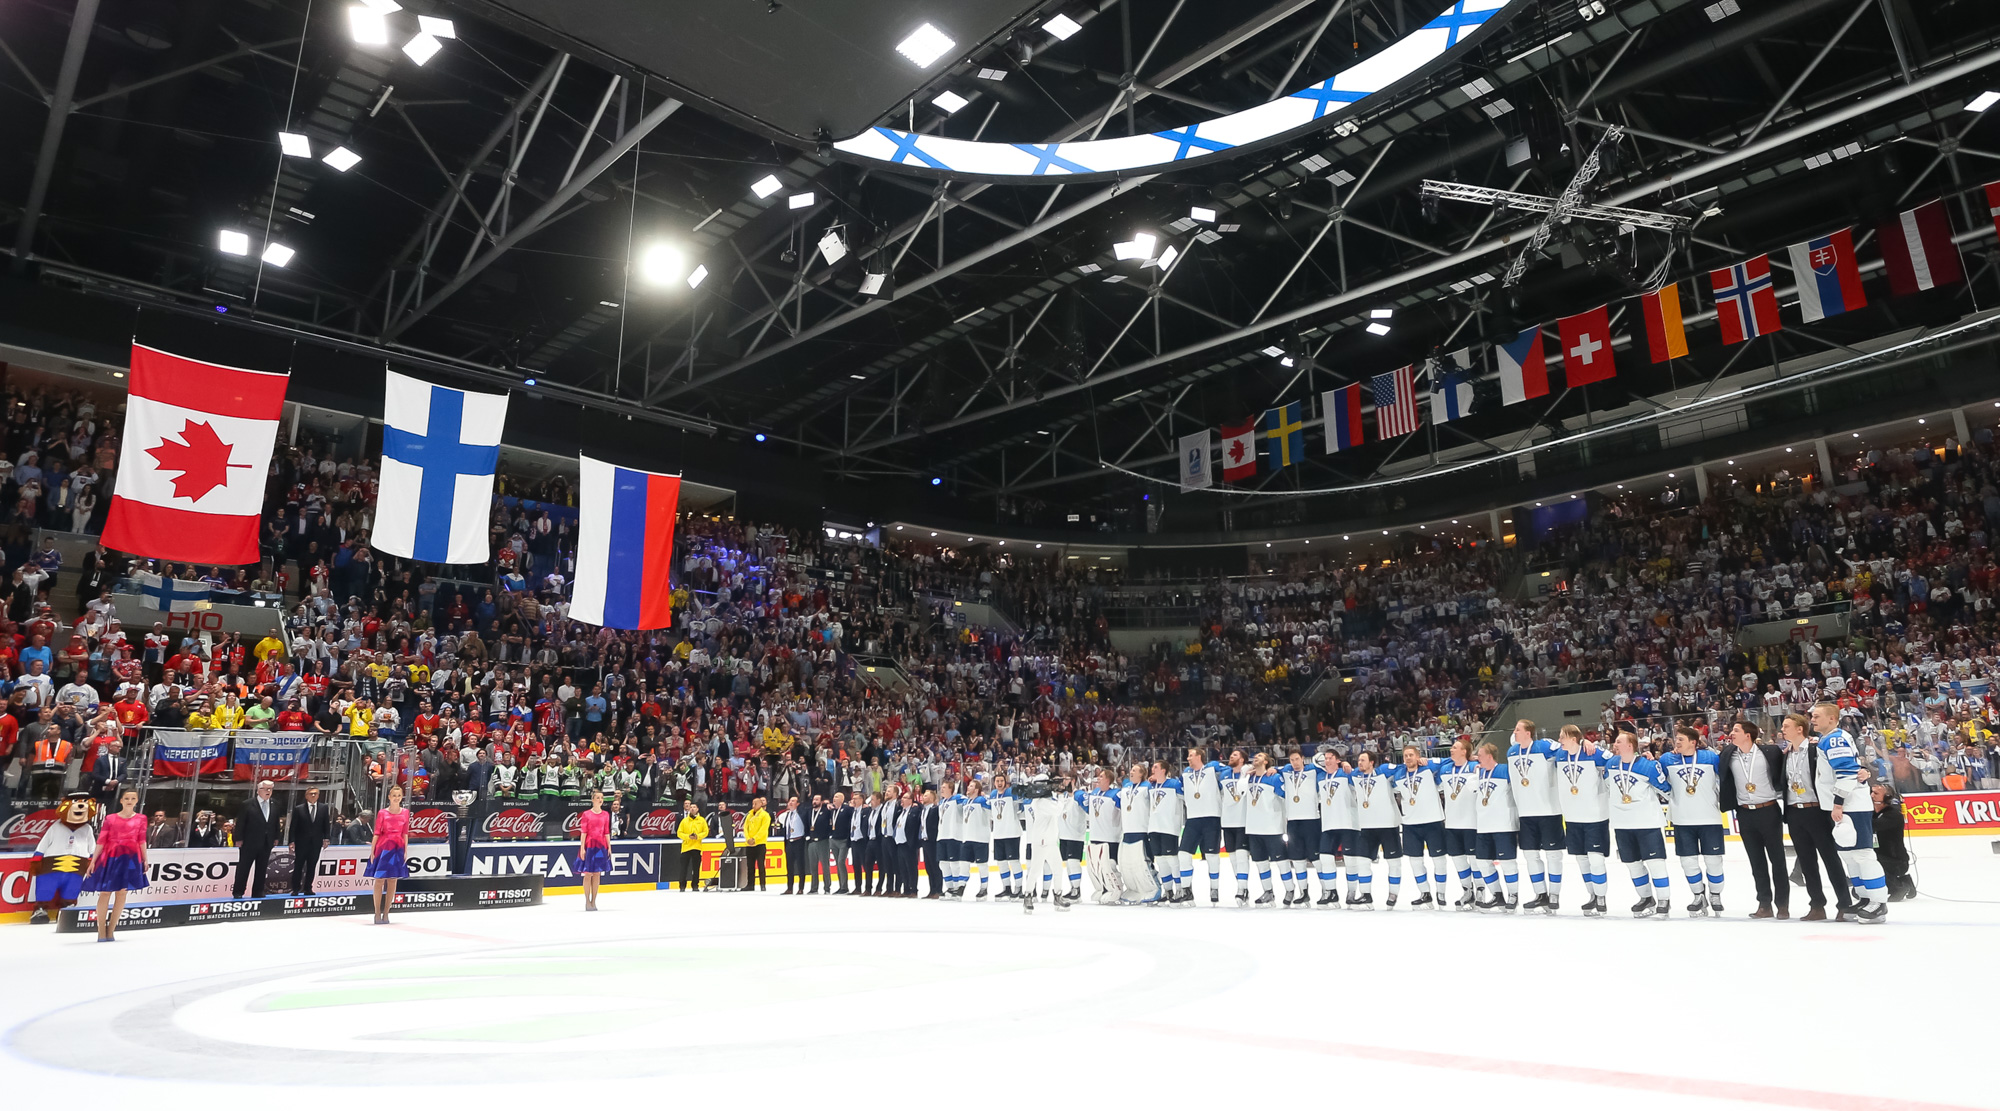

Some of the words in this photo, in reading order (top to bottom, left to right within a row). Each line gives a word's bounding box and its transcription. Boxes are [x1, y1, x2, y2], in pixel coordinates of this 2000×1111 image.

[1829, 736, 1845, 748] 82
[482, 811, 548, 834] Coca-Cola
[472, 853, 574, 878] NIVEA
[603, 852, 654, 876] EN
[130, 884, 177, 896] ATCHES
[183, 884, 218, 893] SINCE
[316, 879, 350, 889] SWISS
[405, 892, 454, 903] TISSOT
[497, 889, 532, 899] TISSOT
[210, 901, 262, 913] TISSOT
[304, 896, 357, 908] TISSOT
[106, 907, 163, 920] TSSOT
